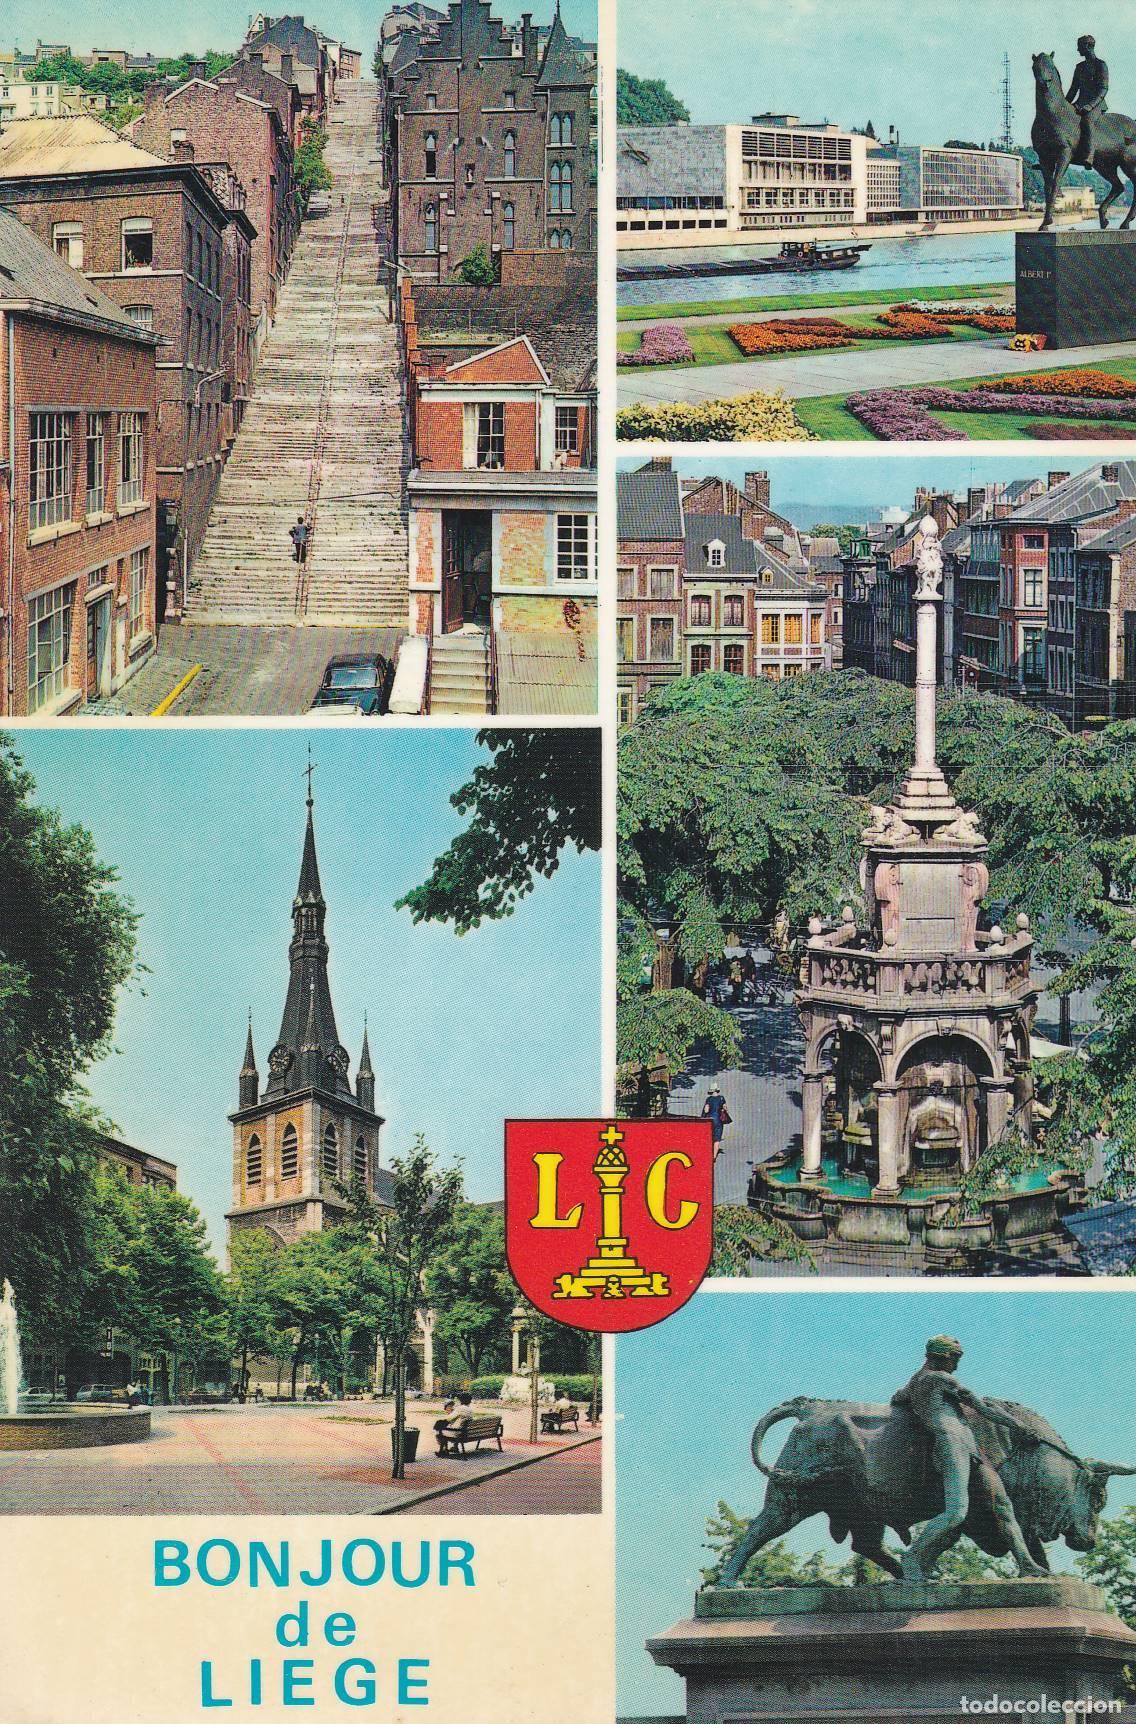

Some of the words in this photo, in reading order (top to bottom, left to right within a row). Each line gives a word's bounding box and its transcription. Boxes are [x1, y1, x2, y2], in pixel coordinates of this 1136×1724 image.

[528, 1151, 585, 1229] L
[153, 1538, 477, 1588] BONJOUR
[275, 1599, 357, 1648] de
[200, 1657, 431, 1708] LIEGE
